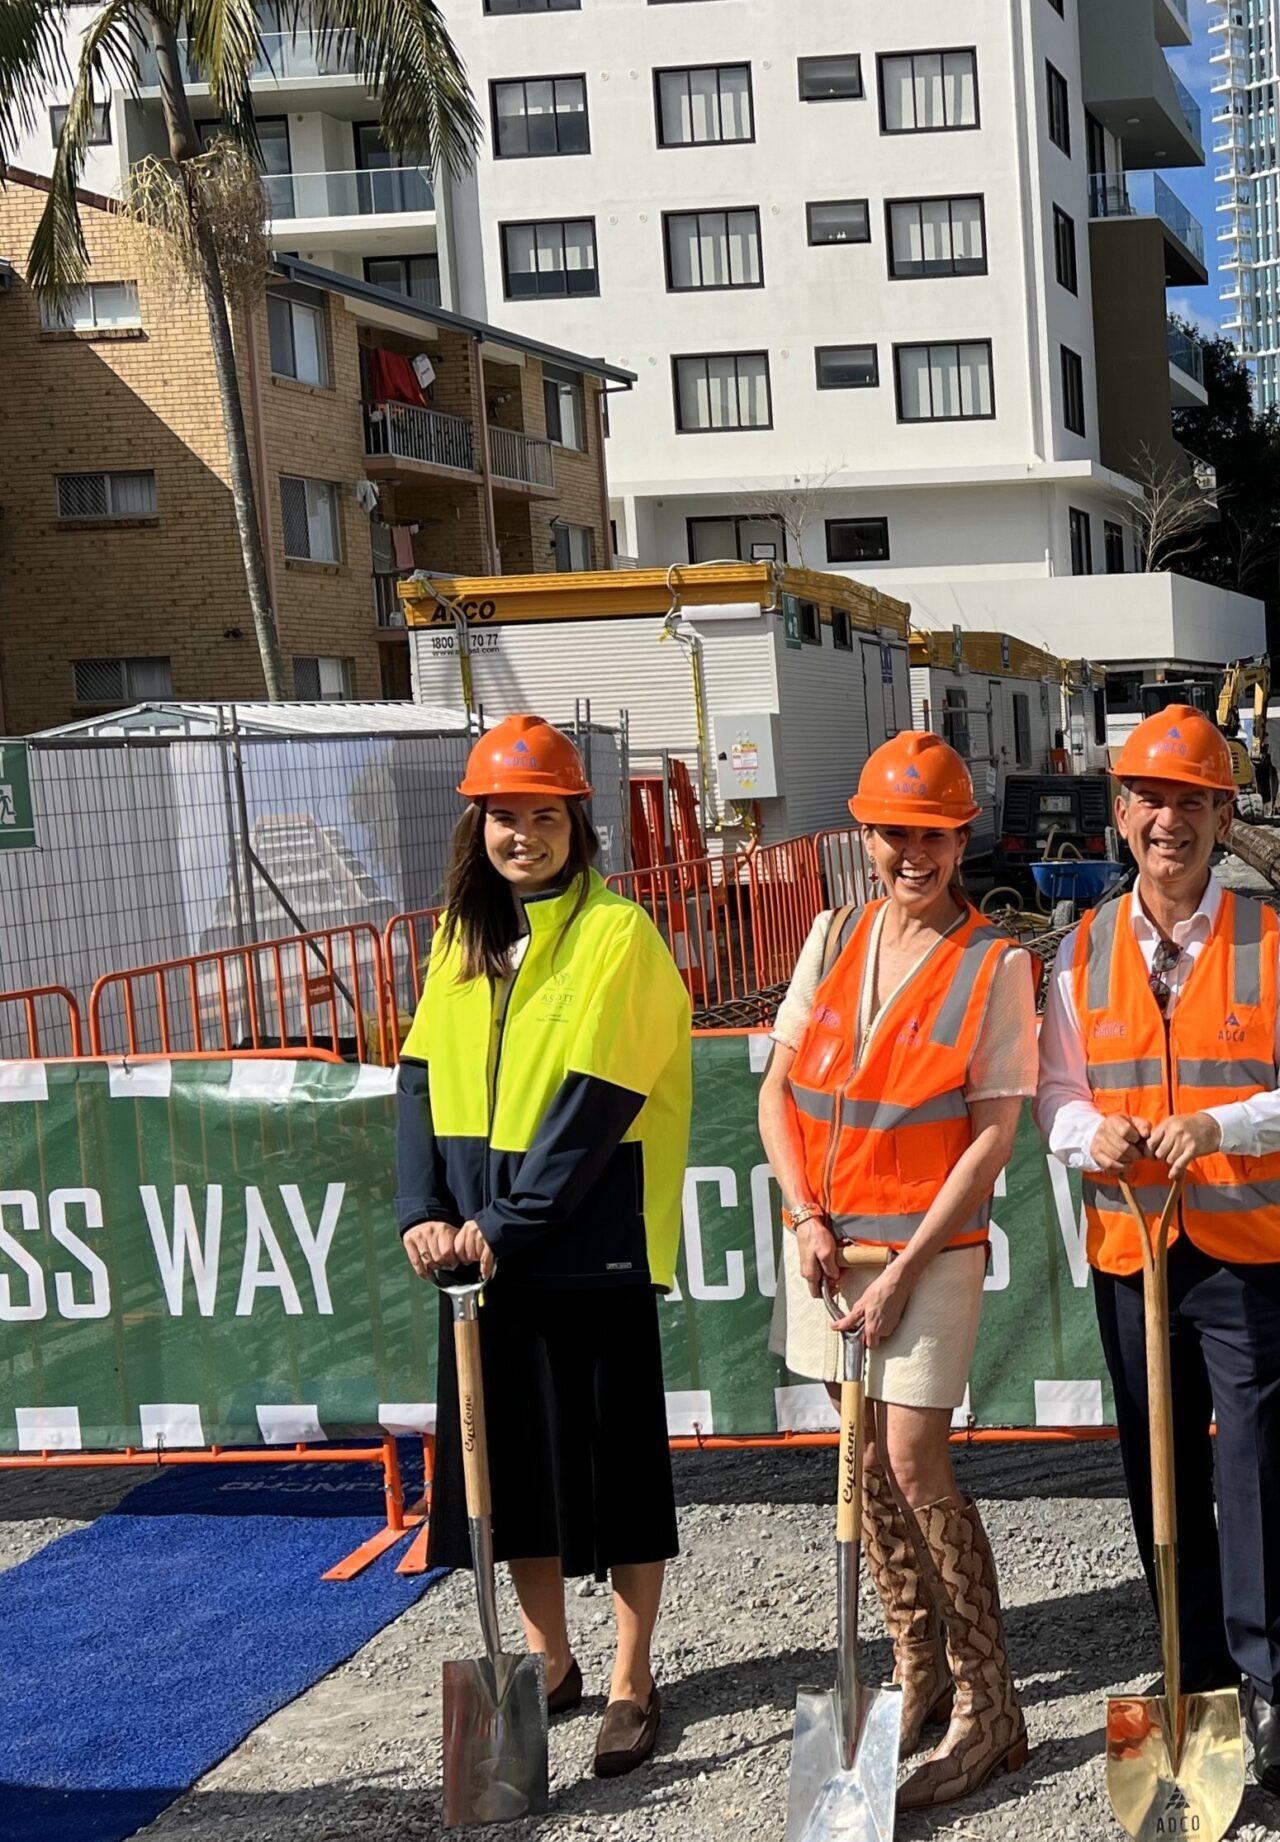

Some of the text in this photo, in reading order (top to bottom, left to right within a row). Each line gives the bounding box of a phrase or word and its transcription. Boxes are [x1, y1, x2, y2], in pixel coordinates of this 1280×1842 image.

[431, 601, 496, 622] ACO
[431, 636, 454, 649] 1800
[1218, 1029, 1245, 1043] ADCO
[138, 1183, 346, 1316] WAY
[463, 1394, 475, 1453] Cyclone
[842, 1421, 856, 1504] Cyclone
[1156, 1815, 1200, 1834] ADCO
